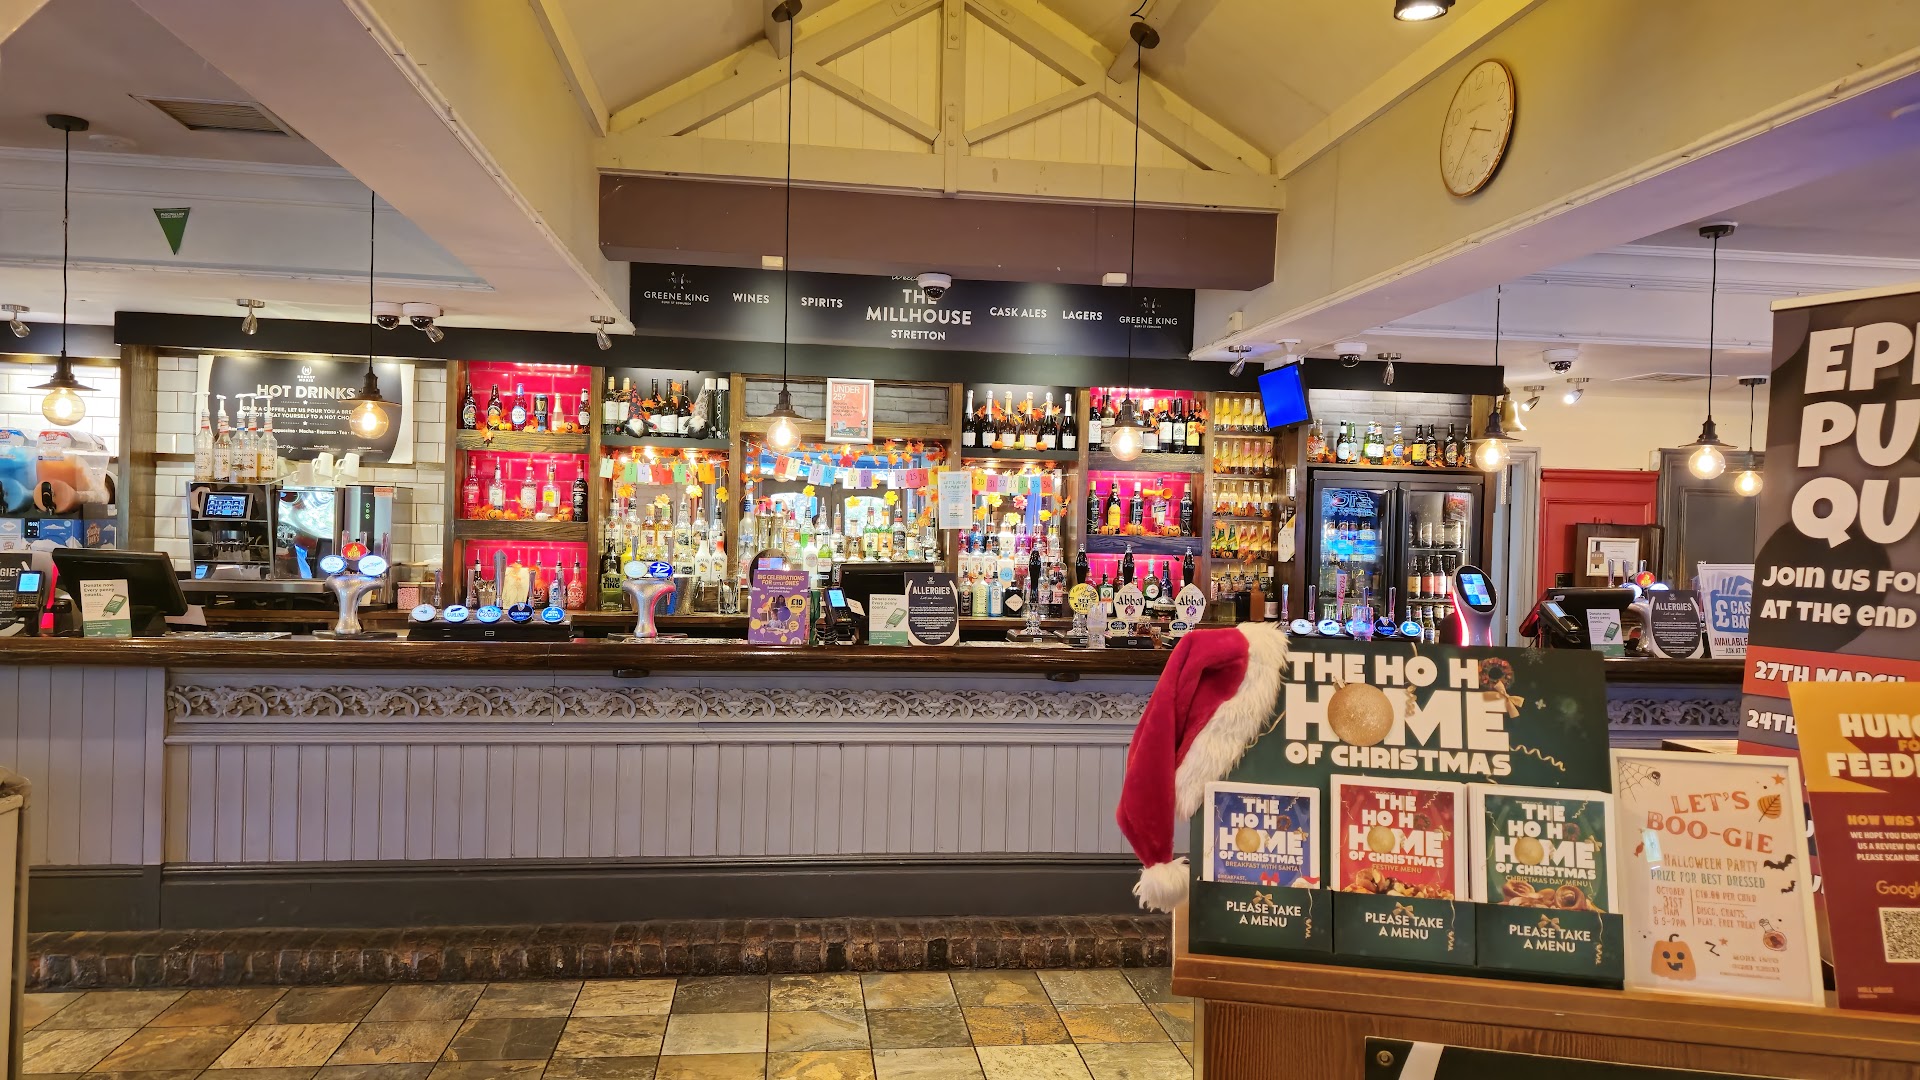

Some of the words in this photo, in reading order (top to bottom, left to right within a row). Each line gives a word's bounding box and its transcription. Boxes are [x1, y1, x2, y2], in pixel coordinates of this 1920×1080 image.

[643, 290, 682, 301] GREENE
[685, 293, 710, 303] KING
[732, 292, 771, 304] WINES
[801, 296, 843, 309] SPIRITS
[866, 305, 973, 326] MILLHOUSE
[989, 306, 1019, 318] CASK
[1021, 308, 1048, 320] ALES
[1062, 310, 1104, 321] LAGERS
[1119, 315, 1153, 325] GREENE
[1155, 317, 1178, 326] KING
[891, 329, 947, 341] STRETTON
[1803, 320, 1920, 396] EP
[257, 383, 292, 398] HOT
[295, 385, 356, 400] DRINKS
[833, 384, 861, 394] UNDER
[833, 393, 847, 401] 25?
[1797, 398, 1920, 469] PU
[1791, 475, 1920, 549] QU
[912, 586, 951, 595] ALLERGIES
[1876, 572, 1920, 598] FO
[1655, 602, 1693, 611] ALLERGIES
[1730, 600, 1751, 616] CAS
[1759, 599, 1792, 620] AT
[1714, 637, 1748, 646] AVAILABLE
[1283, 651, 1367, 685] THE
[1375, 654, 1439, 688] HO
[1897, 739, 1920, 754] FO
[1284, 741, 1324, 766] OF
[1330, 745, 1512, 778] CHRISTMAS
[1241, 797, 1281, 818] THE
[1374, 792, 1417, 812] THE
[1670, 790, 1751, 815] LET'S
[1361, 808, 1394, 826] HO
[1521, 802, 1566, 822] THE
[1230, 812, 1260, 830] HO
[1507, 819, 1542, 839] HO
[1645, 810, 1775, 855] BOO-GIE
[1849, 830, 1864, 840] WE
[1863, 831, 1884, 841] HOPE
[1884, 832, 1902, 841] YOU
[1856, 842, 1869, 852] US
[1868, 842, 1876, 851] A
[1875, 843, 1905, 853] REVIEW
[1219, 849, 1235, 861] OF
[1236, 851, 1304, 866] CHRISTMAS
[1348, 851, 1366, 862] OF
[1367, 854, 1445, 869] CHRISTMAS
[1663, 853, 1722, 871] HALLOWEEN
[1726, 856, 1760, 874] PARTY
[1856, 852, 1885, 862] PLEASE
[1885, 853, 1905, 863] SCAN
[1224, 860, 1261, 870] BREAKFAST
[1261, 862, 1278, 870] WITH
[1278, 864, 1300, 872] SANTA
[1372, 865, 1399, 875] FESTIVE
[1400, 867, 1423, 876] MENU
[1495, 863, 1513, 876] OF
[1515, 865, 1597, 881] CHRISTMAS
[1504, 874, 1548, 884] CHRISTMAS
[1549, 877, 1564, 886] DAY
[1564, 879, 1589, 888] MENU
[1650, 869, 1677, 883] PRIZE
[1679, 873, 1698, 885] FOR
[1700, 873, 1723, 886] BEST
[1726, 874, 1767, 890] DRESSED
[1655, 885, 1686, 897] OCTOBER
[1722, 892, 1737, 902] PER
[1874, 880, 1920, 899] Googl
[1226, 900, 1269, 915] PLEASE
[1272, 904, 1302, 917] TAKE
[1662, 895, 1684, 910] 31ST
[1239, 914, 1249, 925] A
[1250, 916, 1288, 928] MENU
[1364, 912, 1411, 927] PLEASE
[1413, 916, 1444, 929] TAKE
[1378, 927, 1389, 938] A
[1390, 929, 1429, 940] MENU
[1508, 923, 1557, 940] PLEASE
[1558, 928, 1592, 942] TAKE
[1523, 939, 1534, 950] A
[1535, 940, 1577, 954] MENU
